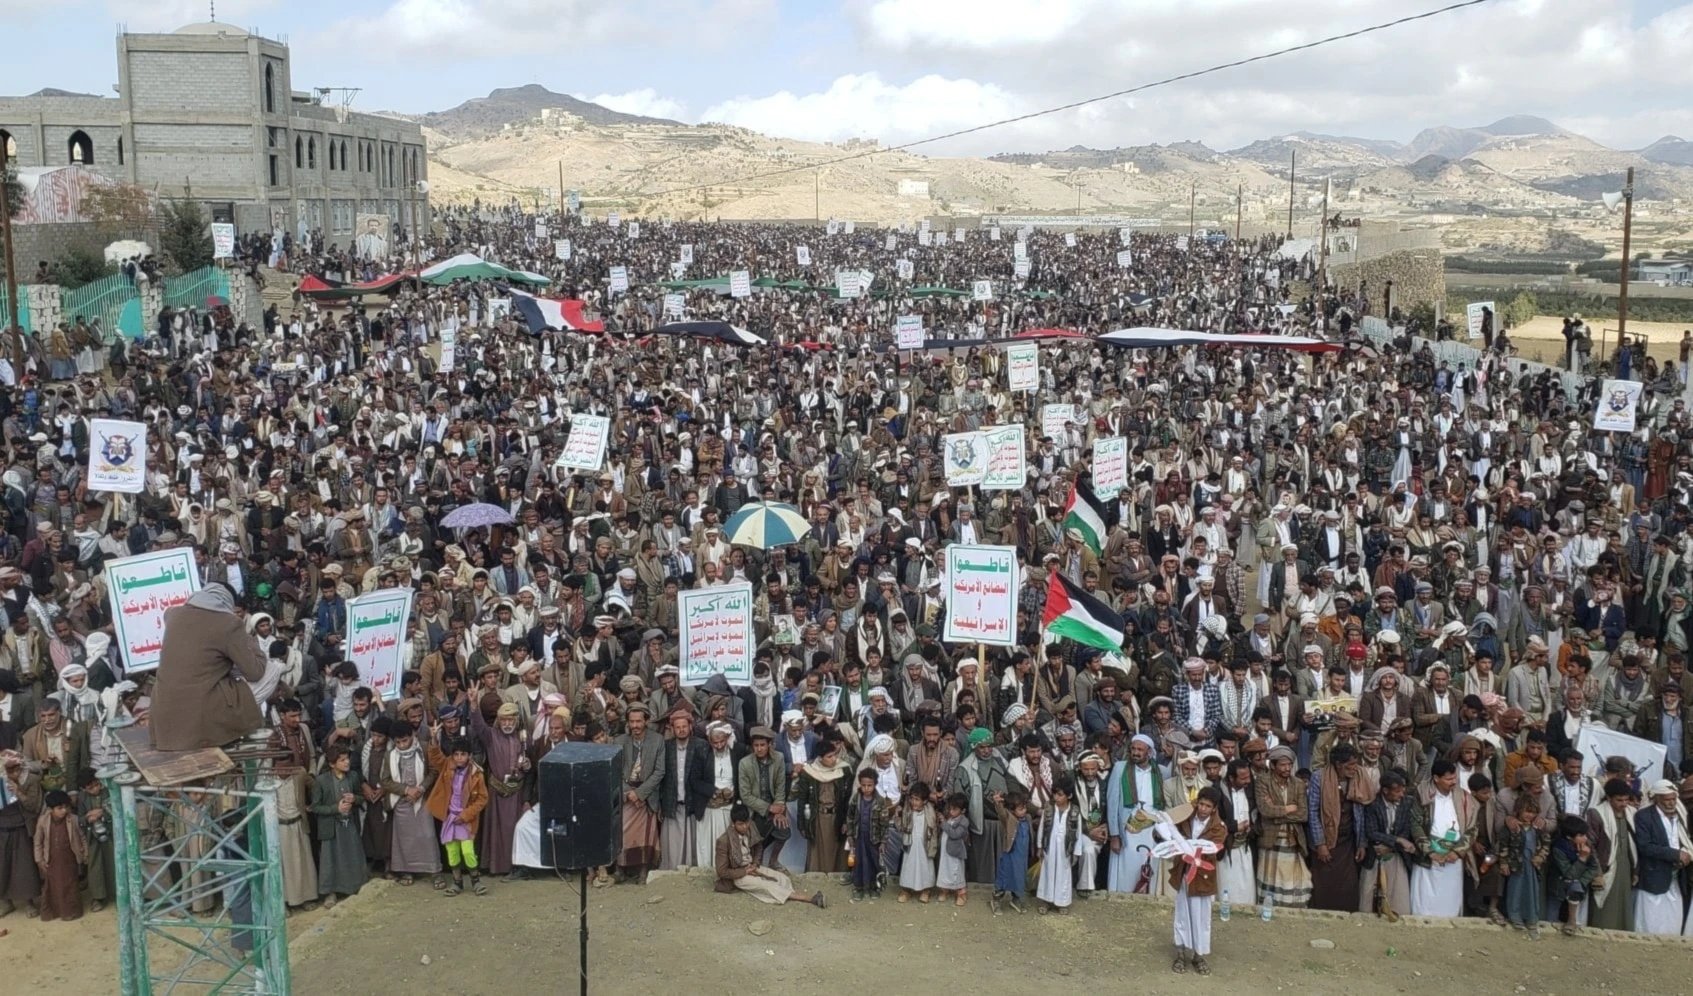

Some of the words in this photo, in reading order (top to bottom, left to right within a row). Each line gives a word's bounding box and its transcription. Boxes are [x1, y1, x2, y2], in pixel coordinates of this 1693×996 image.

[954, 555, 1009, 574] قاطعوا
[115, 562, 187, 595] قاطعوا
[954, 577, 982, 595] الأمريكية
[983, 581, 1009, 596] البضائع
[121, 593, 159, 617] الأمريكية
[689, 594, 723, 618] أكبر
[725, 596, 747, 610] الله
[353, 606, 401, 634] قاطعوا
[721, 615, 746, 627] الموت
[953, 614, 1008, 634] الإسرائيلية
[721, 630, 746, 642] الموت
[723, 658, 746, 674] النصر
